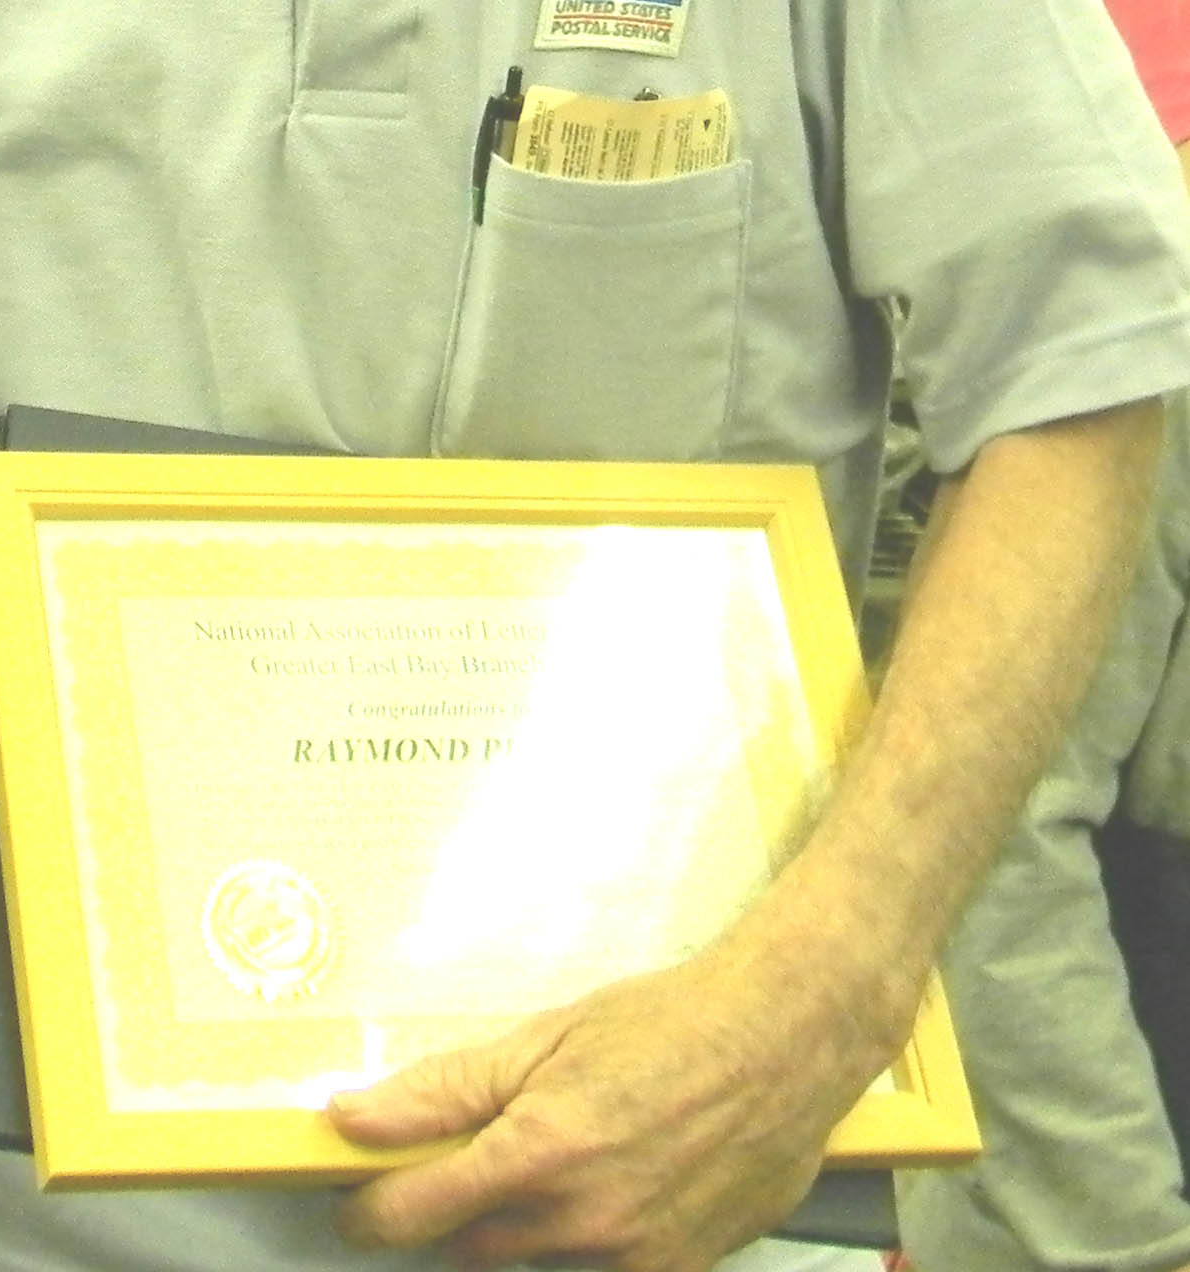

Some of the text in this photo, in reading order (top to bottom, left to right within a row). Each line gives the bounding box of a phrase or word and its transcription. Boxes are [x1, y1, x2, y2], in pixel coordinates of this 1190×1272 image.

[556, 0, 673, 20] UNITED STATES
[550, 20, 671, 43] POSTAL SERVICE
[195, 620, 295, 641] National
[305, 620, 442, 641] Association
[450, 619, 475, 641] of
[250, 652, 545, 681] Greater East Bay Branch
[347, 700, 506, 720] Congratulations
[293, 737, 470, 763] RAYMOND
